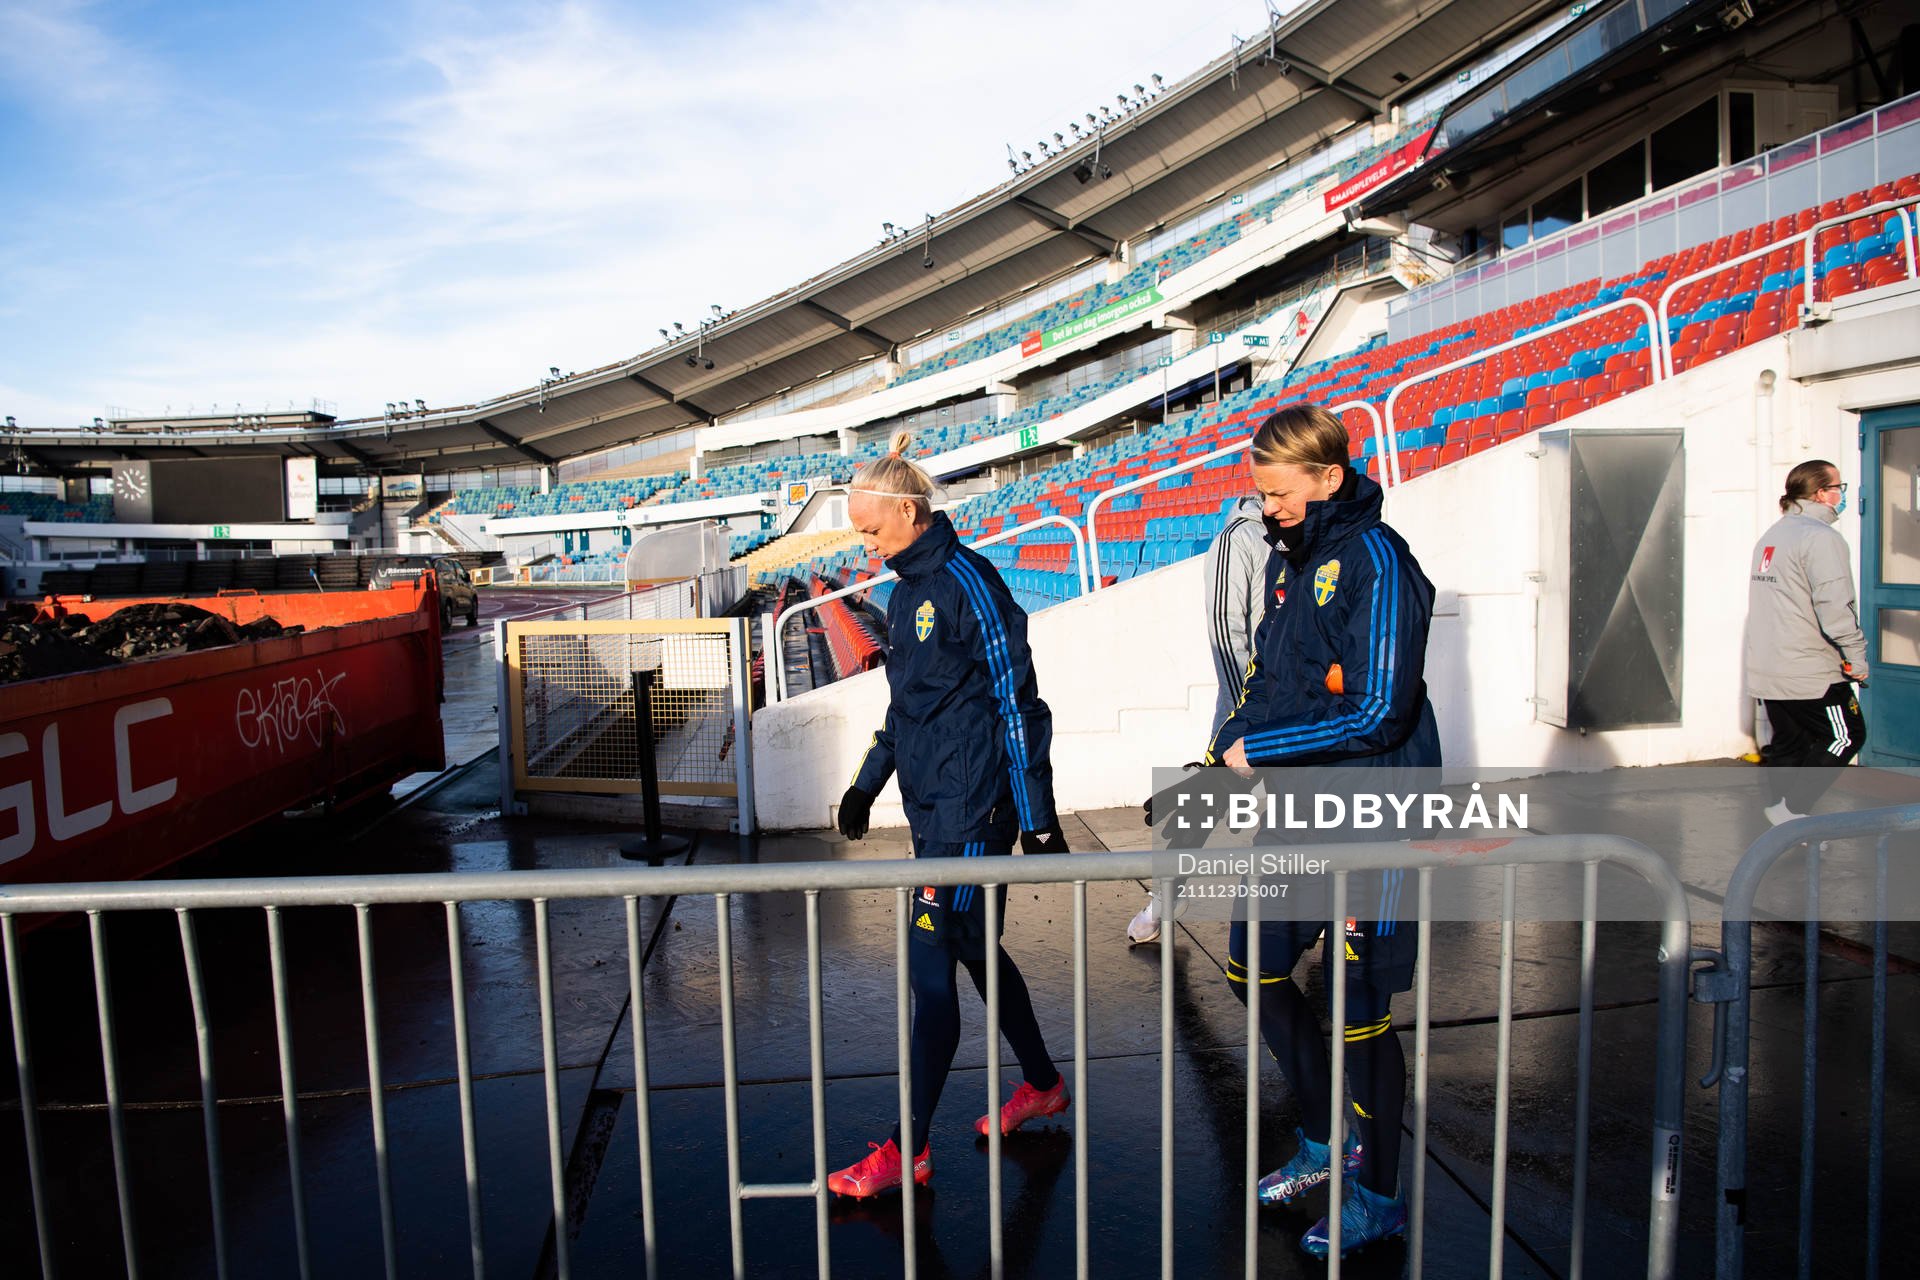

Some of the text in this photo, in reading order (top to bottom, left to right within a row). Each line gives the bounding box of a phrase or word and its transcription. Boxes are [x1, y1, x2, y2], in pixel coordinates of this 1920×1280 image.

[1052, 331, 1065, 342] Det
[1082, 316, 1098, 330] dag
[1097, 304, 1129, 323] imorgon
[1129, 291, 1152, 310] också
[1212, 333, 1223, 341] L3
[1160, 358, 1170, 366] L4
